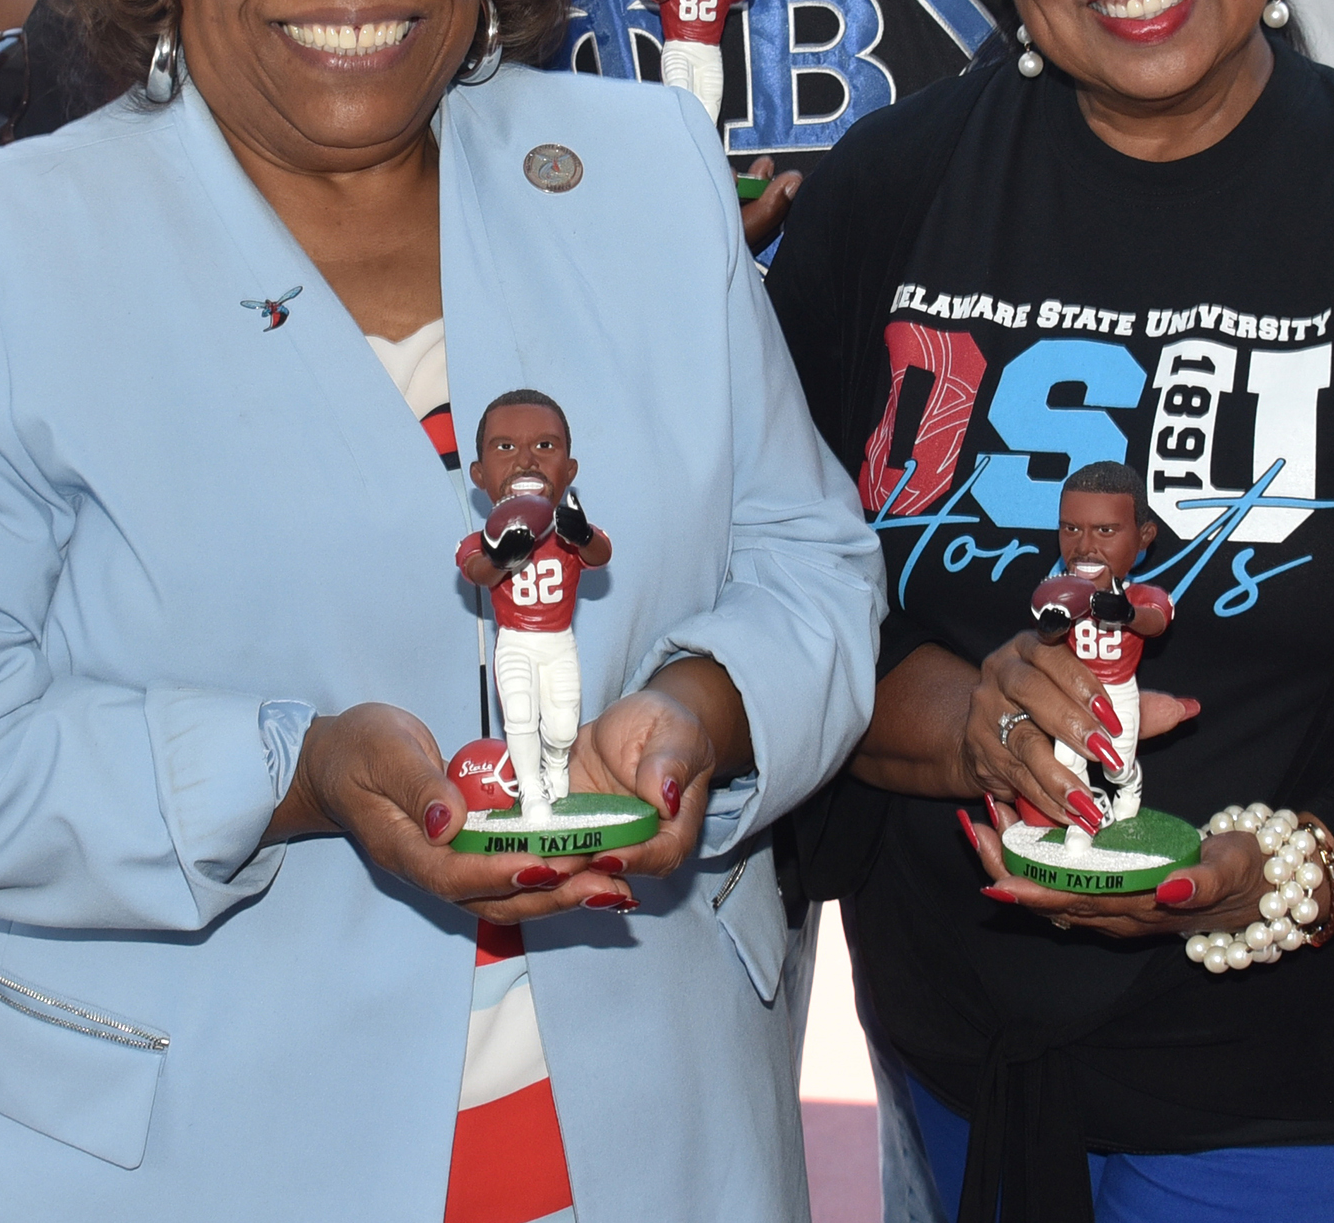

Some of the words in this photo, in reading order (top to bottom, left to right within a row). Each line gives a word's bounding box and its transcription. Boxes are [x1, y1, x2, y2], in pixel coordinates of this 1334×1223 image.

[857, 320, 1333, 544] DSU
[1153, 354, 1216, 494] 1891
[512, 558, 563, 606] 82
[1075, 619, 1122, 660] 82
[484, 835, 529, 853] JOHN
[539, 830, 603, 853] TAYLOR
[1023, 863, 1058, 884] JOHN
[1066, 873, 1124, 890] TAYLOR
